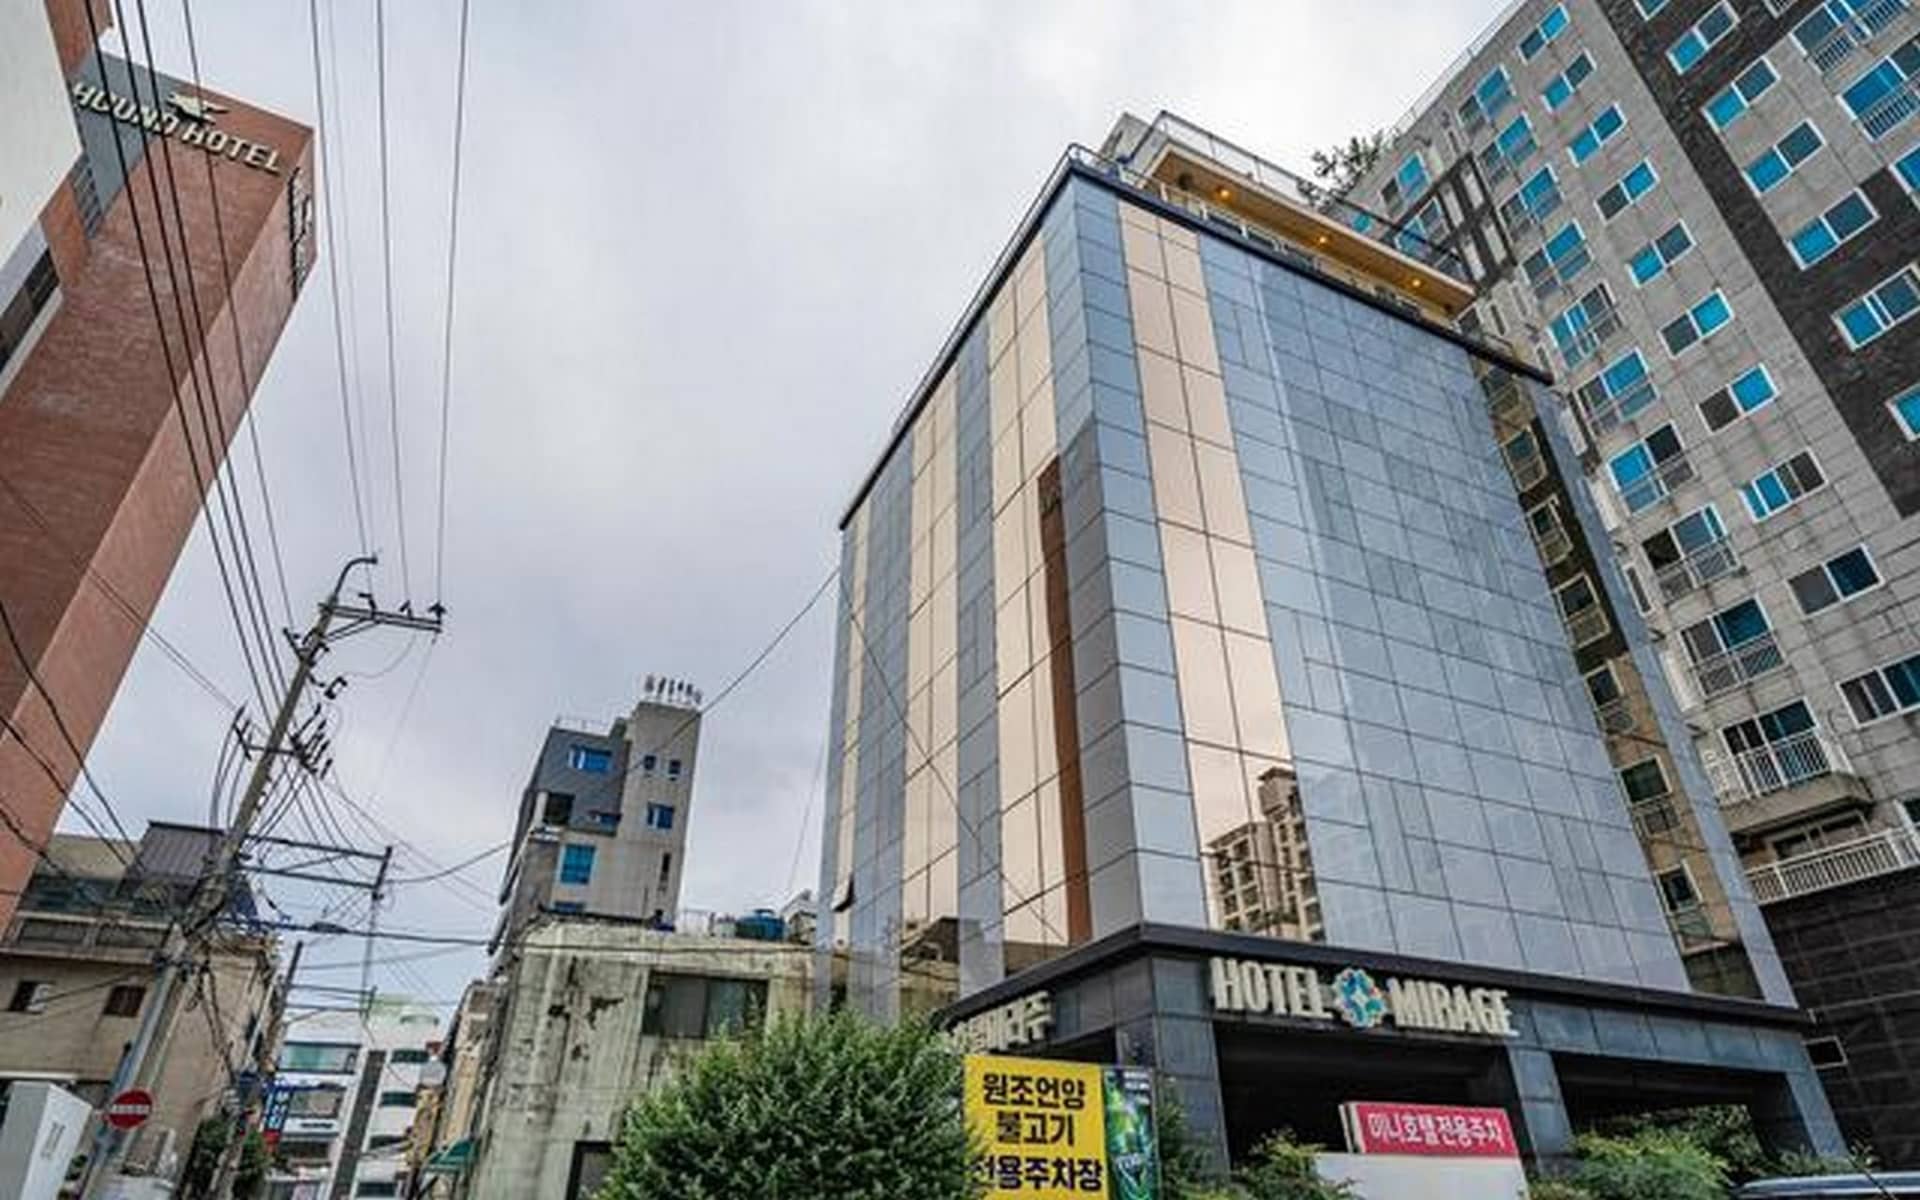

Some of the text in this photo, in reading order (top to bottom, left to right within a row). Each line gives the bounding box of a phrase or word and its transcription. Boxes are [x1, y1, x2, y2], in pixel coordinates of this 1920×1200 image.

[182, 121, 283, 173] HOTEL
[1211, 957, 1519, 1037] HOTEL MIRAGE
[983, 1073, 1085, 1110] 원조언양
[997, 1110, 1074, 1147] 불고기
